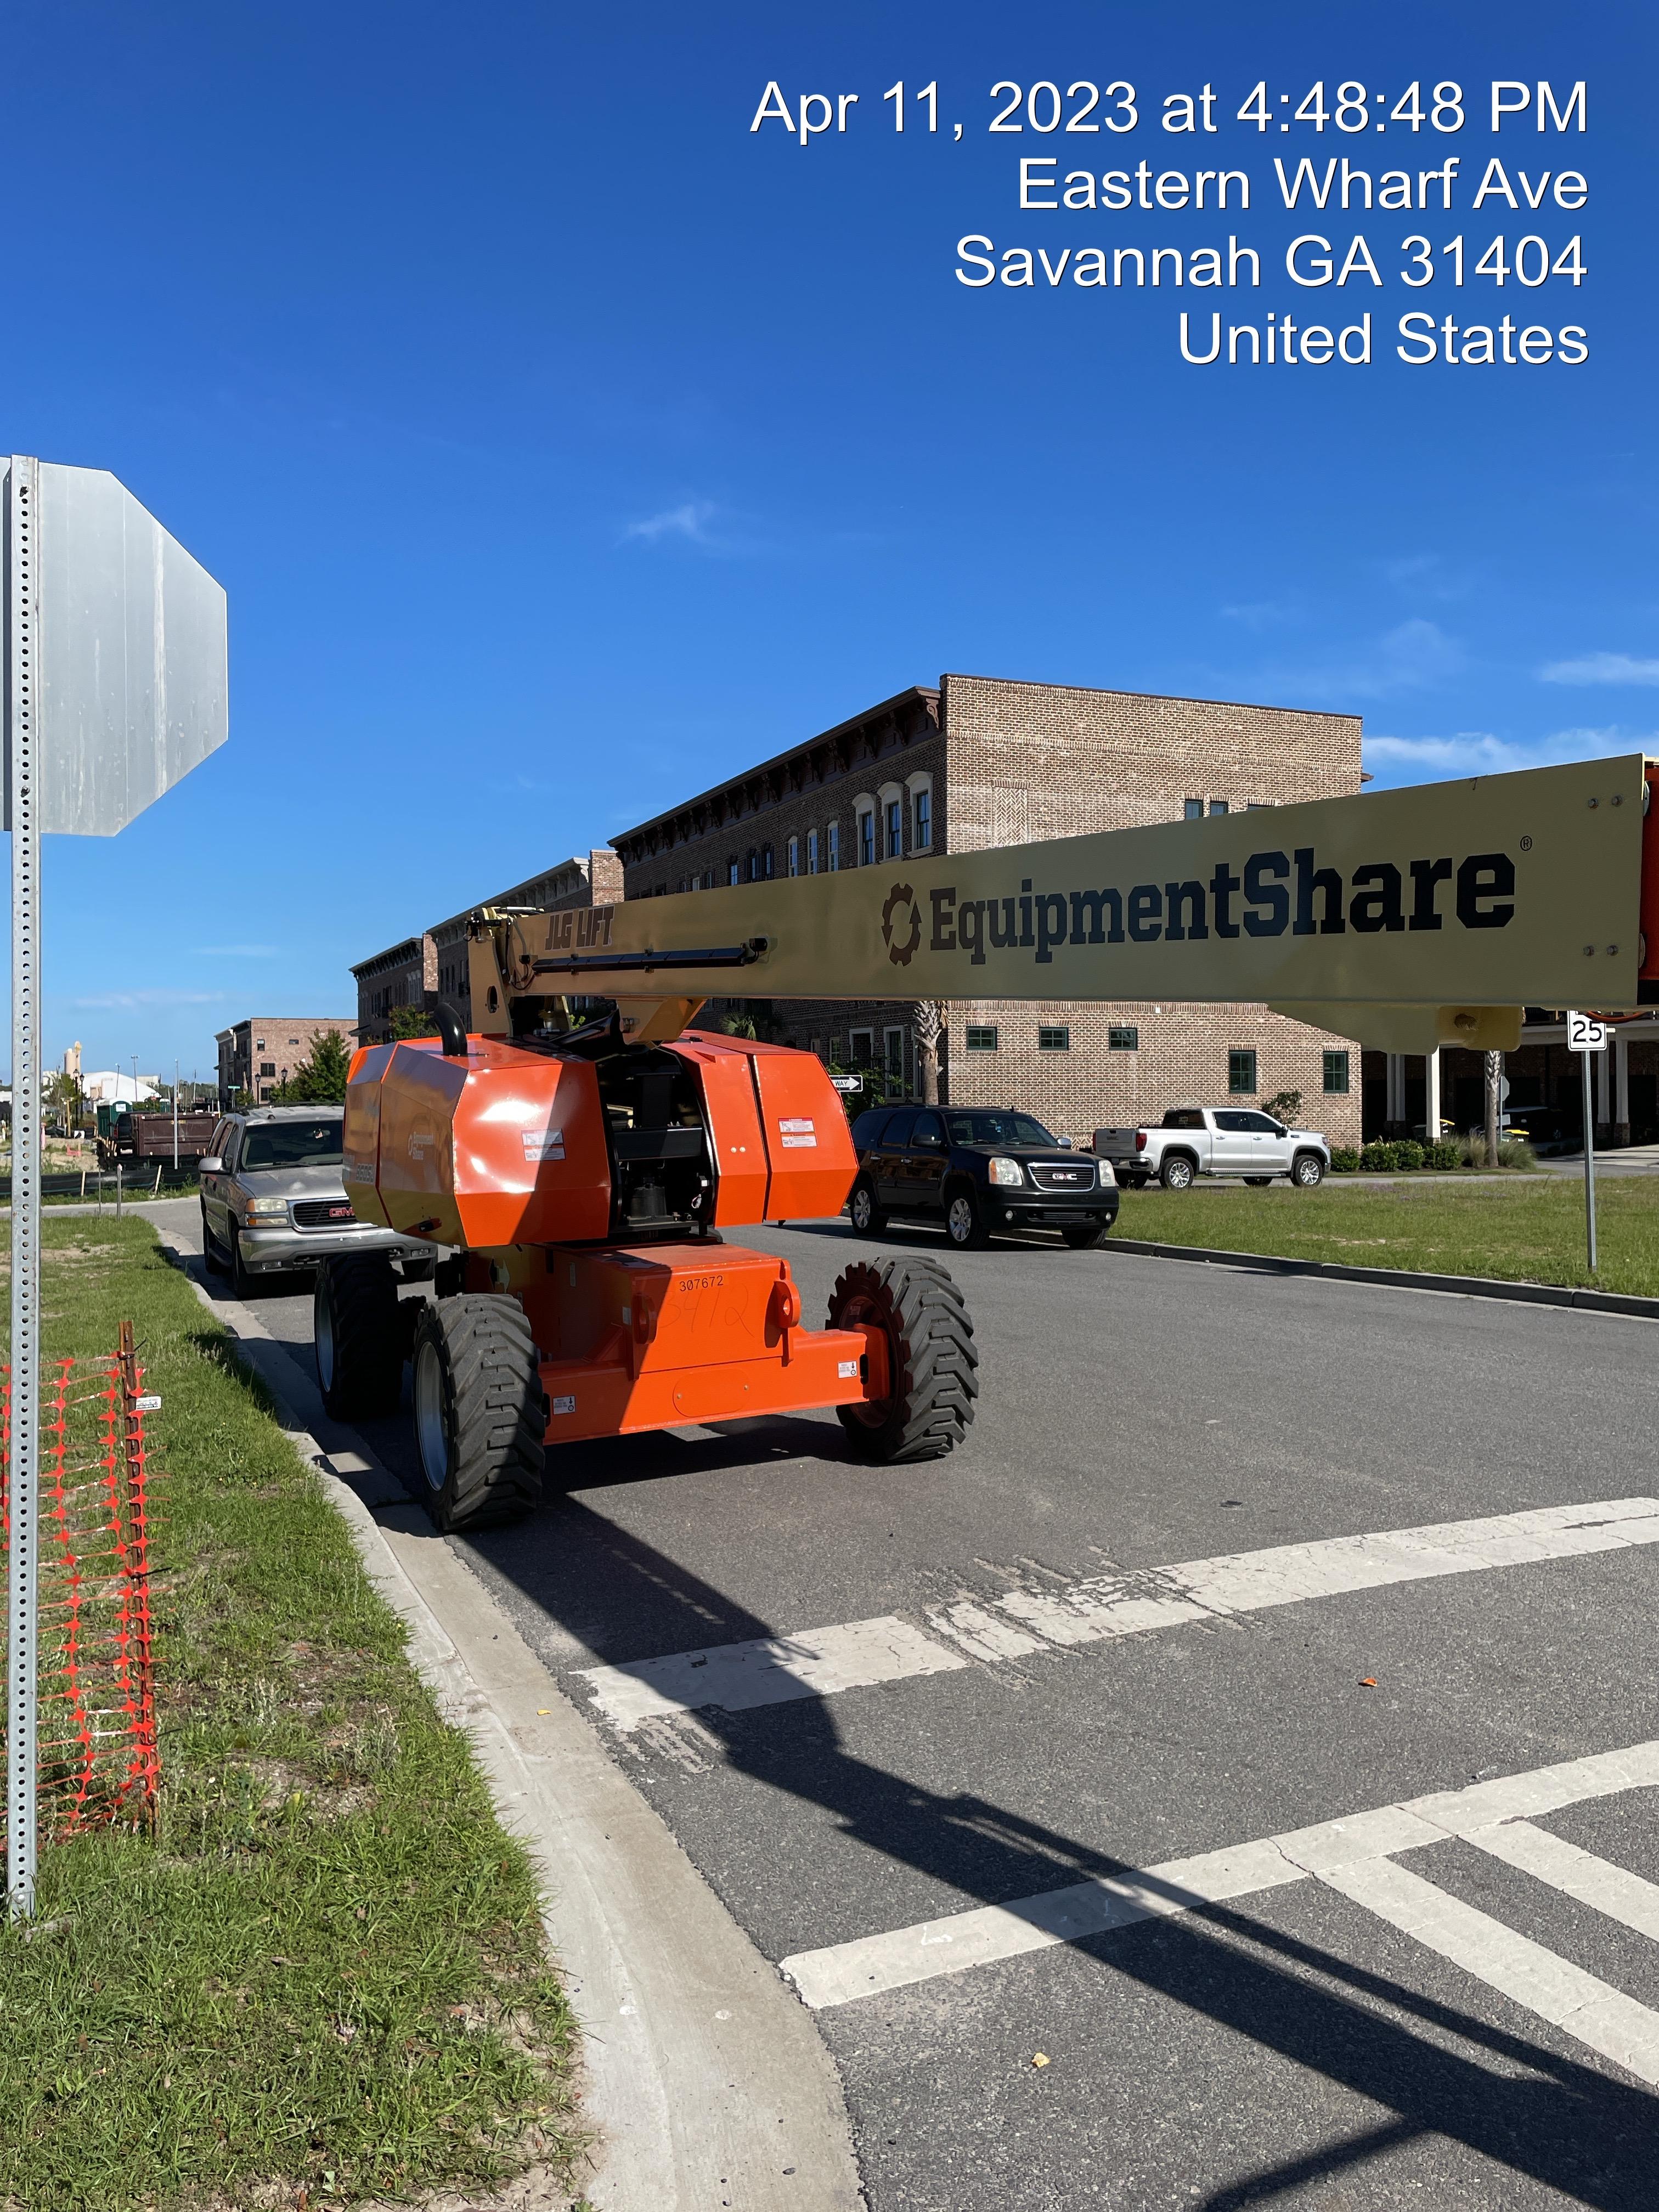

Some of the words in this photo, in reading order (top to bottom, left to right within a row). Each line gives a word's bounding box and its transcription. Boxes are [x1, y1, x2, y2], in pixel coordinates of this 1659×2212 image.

[929, 847, 1516, 965] EquipmentShare
[545, 910, 574, 951] JLG
[575, 905, 615, 949] LIFT
[1572, 1020, 1602, 1042] 25
[329, 1206, 356, 1217] GM
[679, 1275, 724, 1292] 307672
